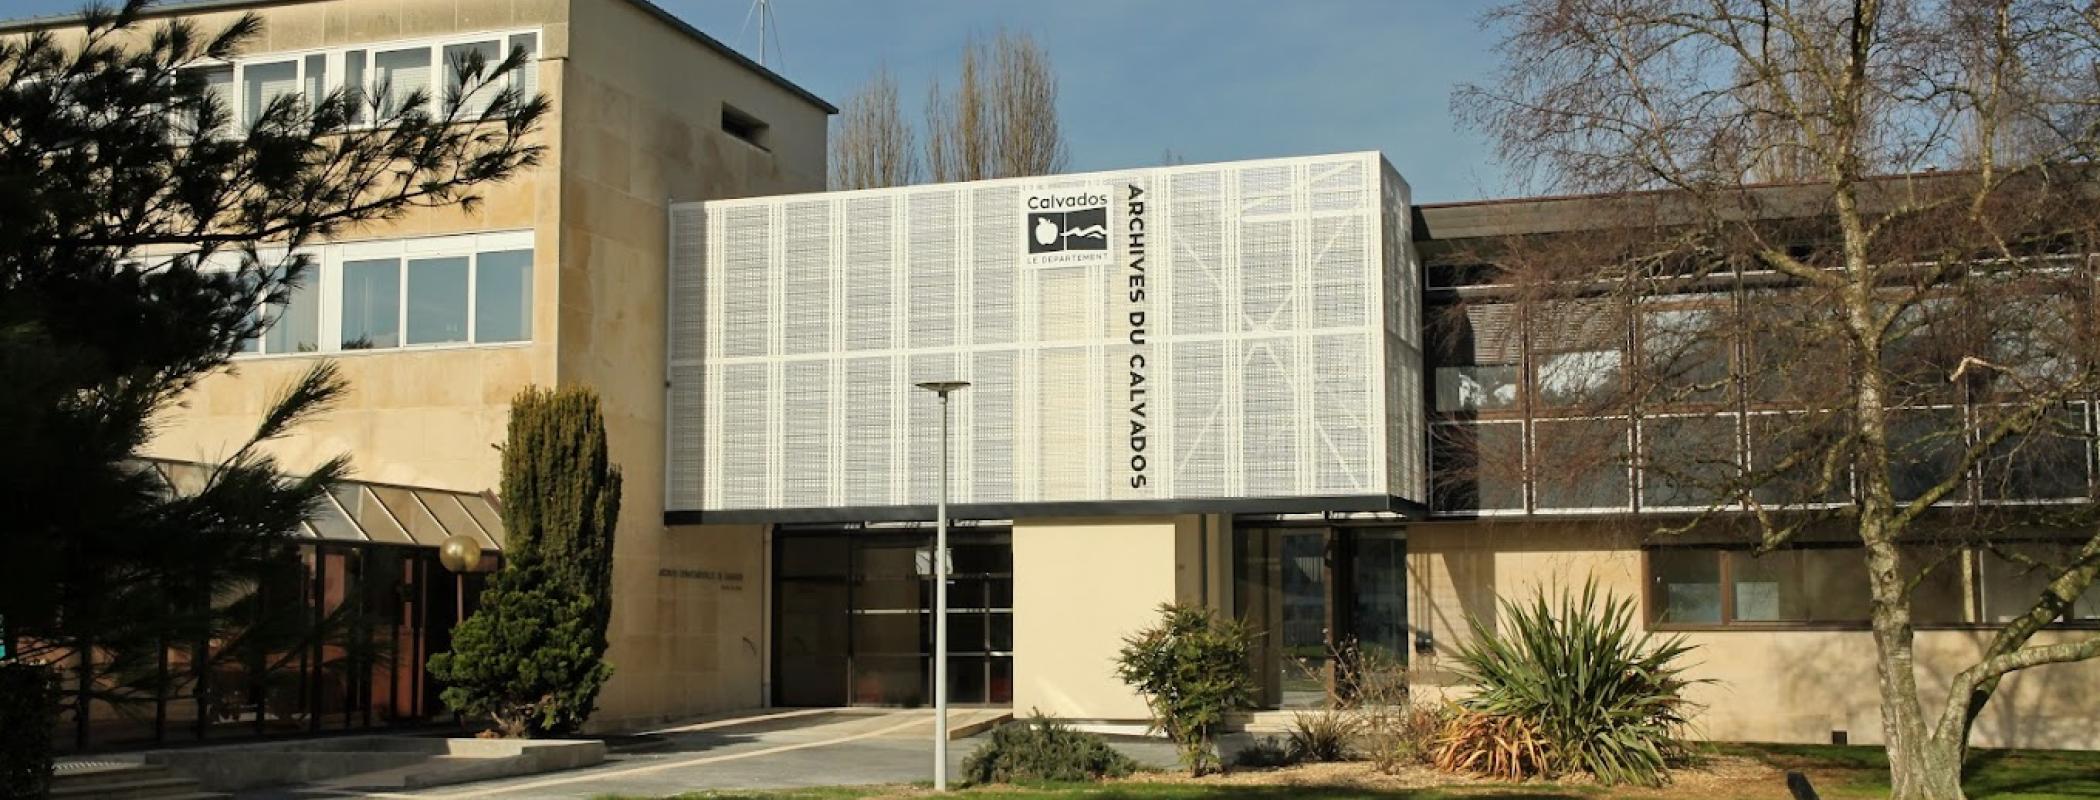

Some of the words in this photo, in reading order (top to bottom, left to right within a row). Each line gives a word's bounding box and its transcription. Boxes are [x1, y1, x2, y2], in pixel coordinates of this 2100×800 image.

[1028, 192, 1107, 209] Calvados
[1027, 256, 1039, 265] LE
[1128, 184, 1145, 303] ARCHIVES
[1129, 311, 1145, 345] DU
[1129, 354, 1147, 489] CALVADOS
